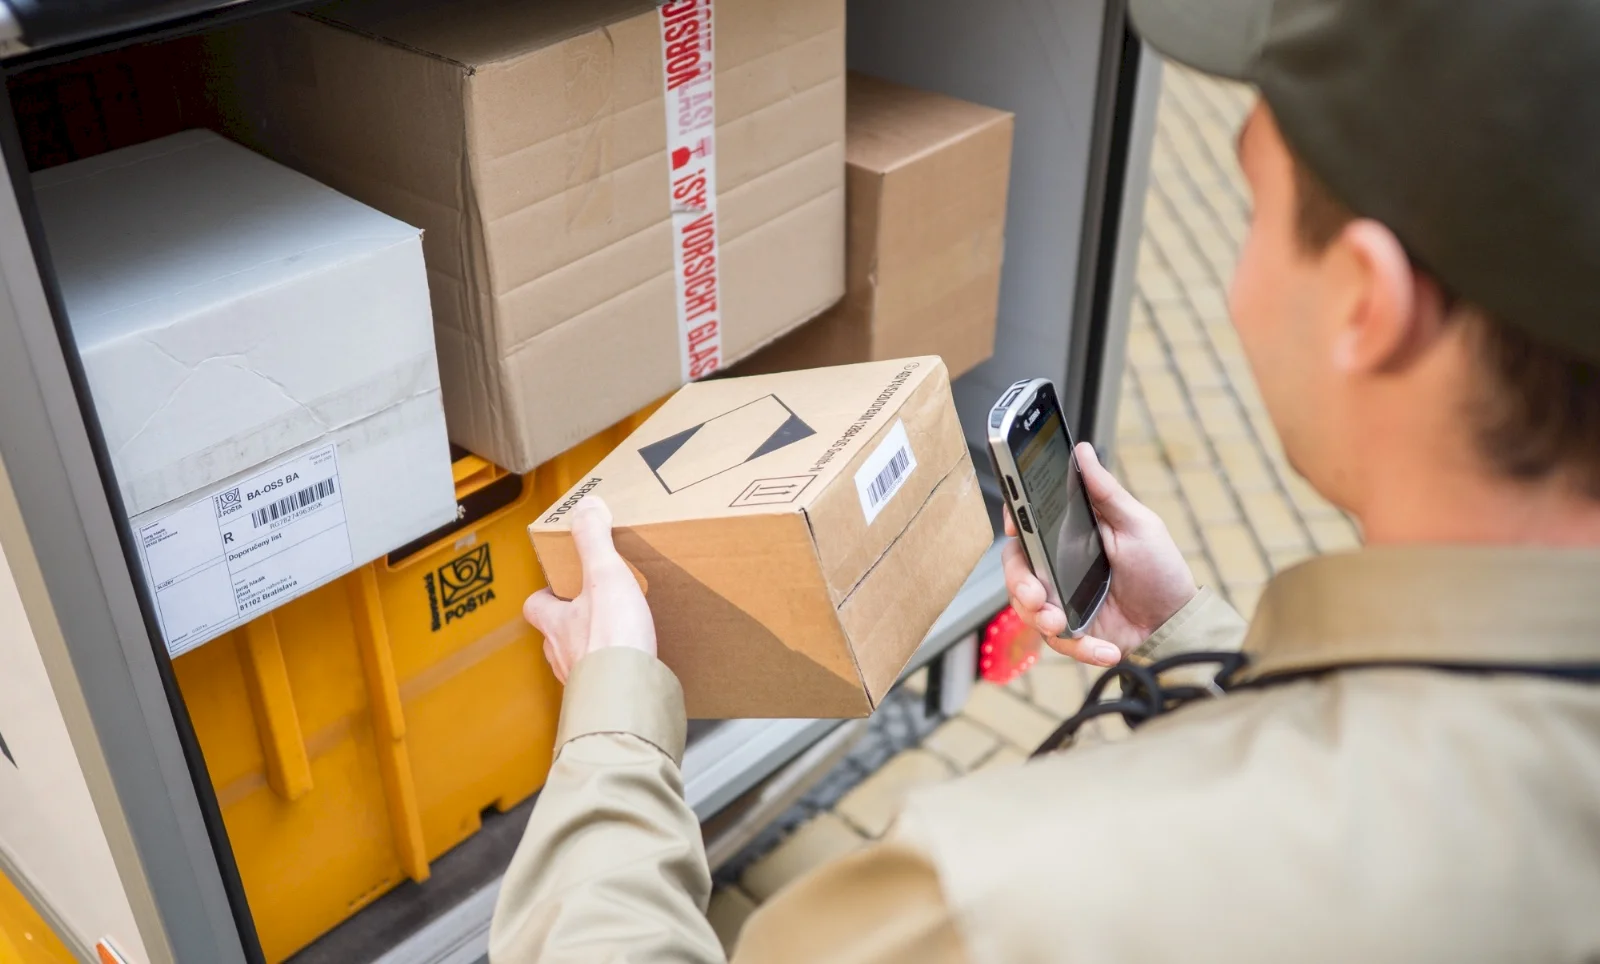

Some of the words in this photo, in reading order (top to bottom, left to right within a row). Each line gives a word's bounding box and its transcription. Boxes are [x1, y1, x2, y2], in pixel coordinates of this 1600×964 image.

[681, 212, 716, 321] VORSICHT
[246, 477, 284, 501] BA-OSS
[285, 470, 299, 483] BA
[545, 478, 602, 524] AEROSOLS
[223, 502, 242, 516] POŠTA
[223, 530, 234, 544] R
[228, 536, 269, 562] Doporučený
[270, 531, 281, 541] list
[239, 596, 261, 611] 81102
[262, 578, 297, 600] Bratislava
